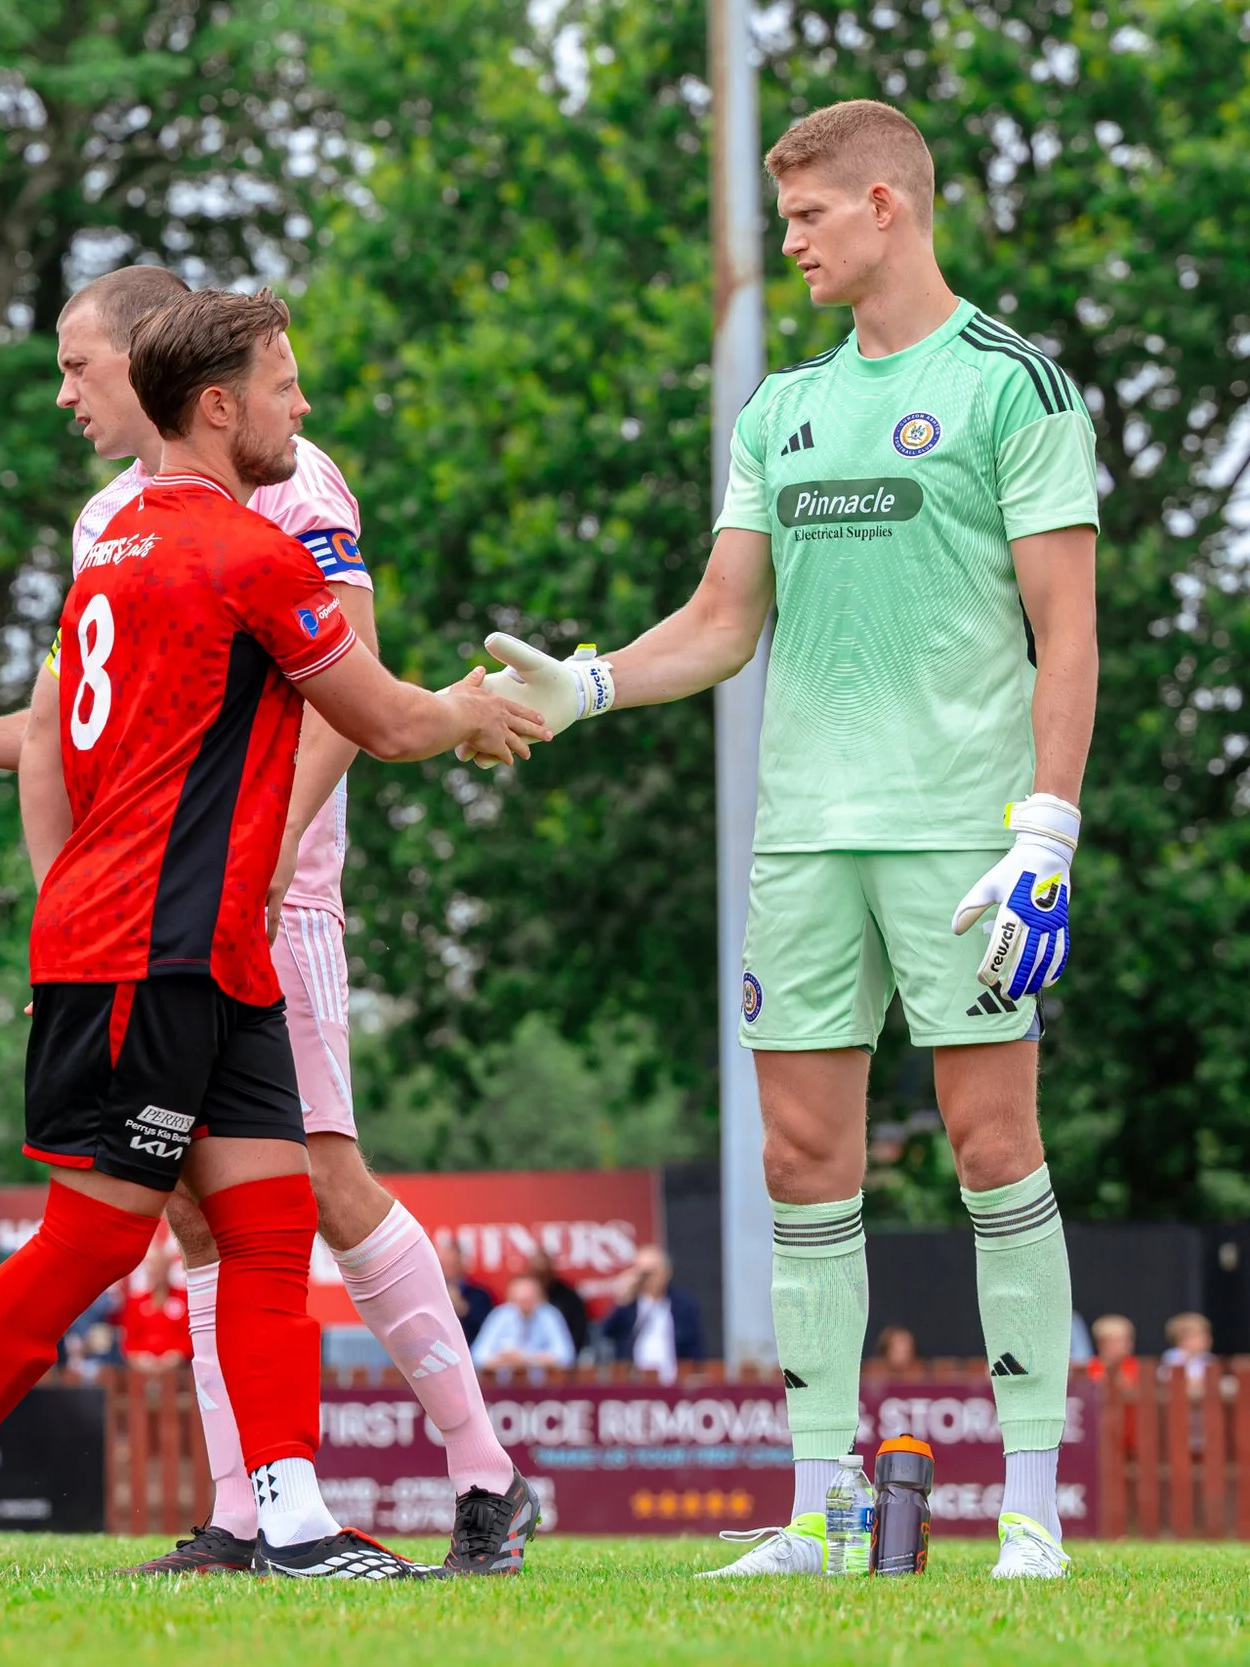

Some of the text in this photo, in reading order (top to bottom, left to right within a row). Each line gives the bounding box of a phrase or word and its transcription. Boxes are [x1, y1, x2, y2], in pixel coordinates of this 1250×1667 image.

[794, 487, 895, 518] Pinnacle
[331, 532, 362, 564] C
[794, 526, 893, 541] Electrical Supplies
[71, 593, 115, 751] 8
[990, 922, 1016, 973] reusch
[125, 1119, 157, 1136] Perrys
[157, 1129, 172, 1140] Kia
[143, 1108, 193, 1130] PERRYS
